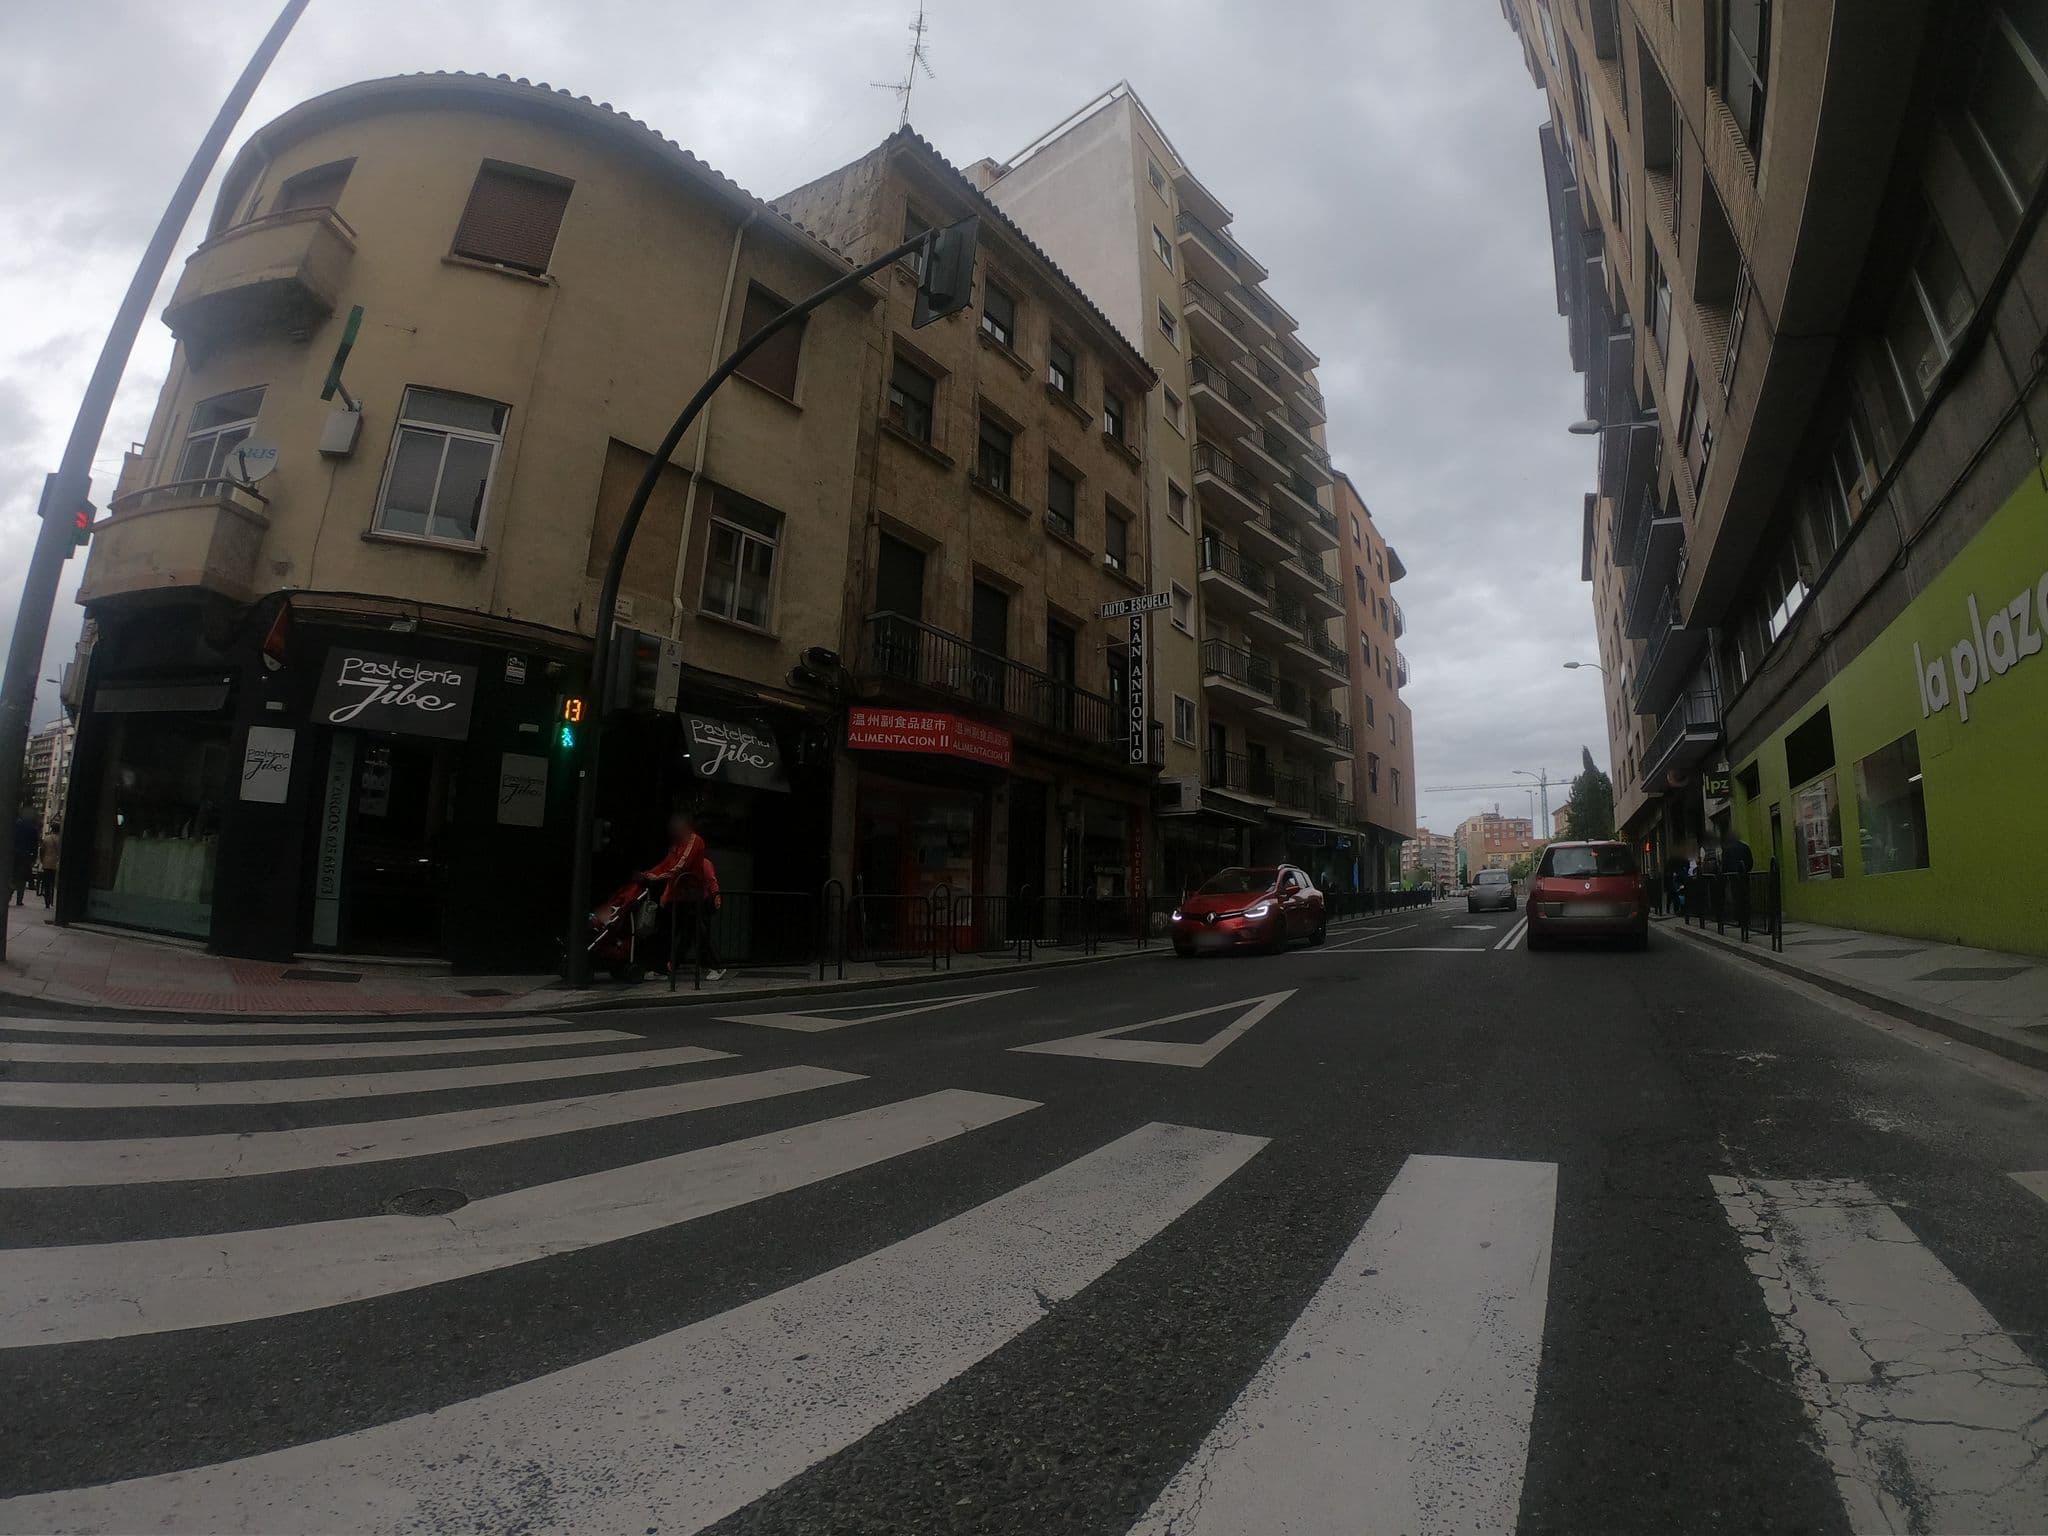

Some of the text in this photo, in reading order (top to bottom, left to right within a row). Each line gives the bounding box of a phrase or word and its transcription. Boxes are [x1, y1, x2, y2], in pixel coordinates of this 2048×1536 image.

[1103, 593, 1168, 617] AUTO- ESCUELA
[1131, 618, 1143, 761] SAN ANTONIO
[1912, 640, 1950, 719] la
[564, 699, 582, 722] 13
[851, 712, 947, 731] 温州副食品超市
[849, 732, 936, 747] ALIMENTACION
[952, 741, 1004, 761] ALIMENTACION
